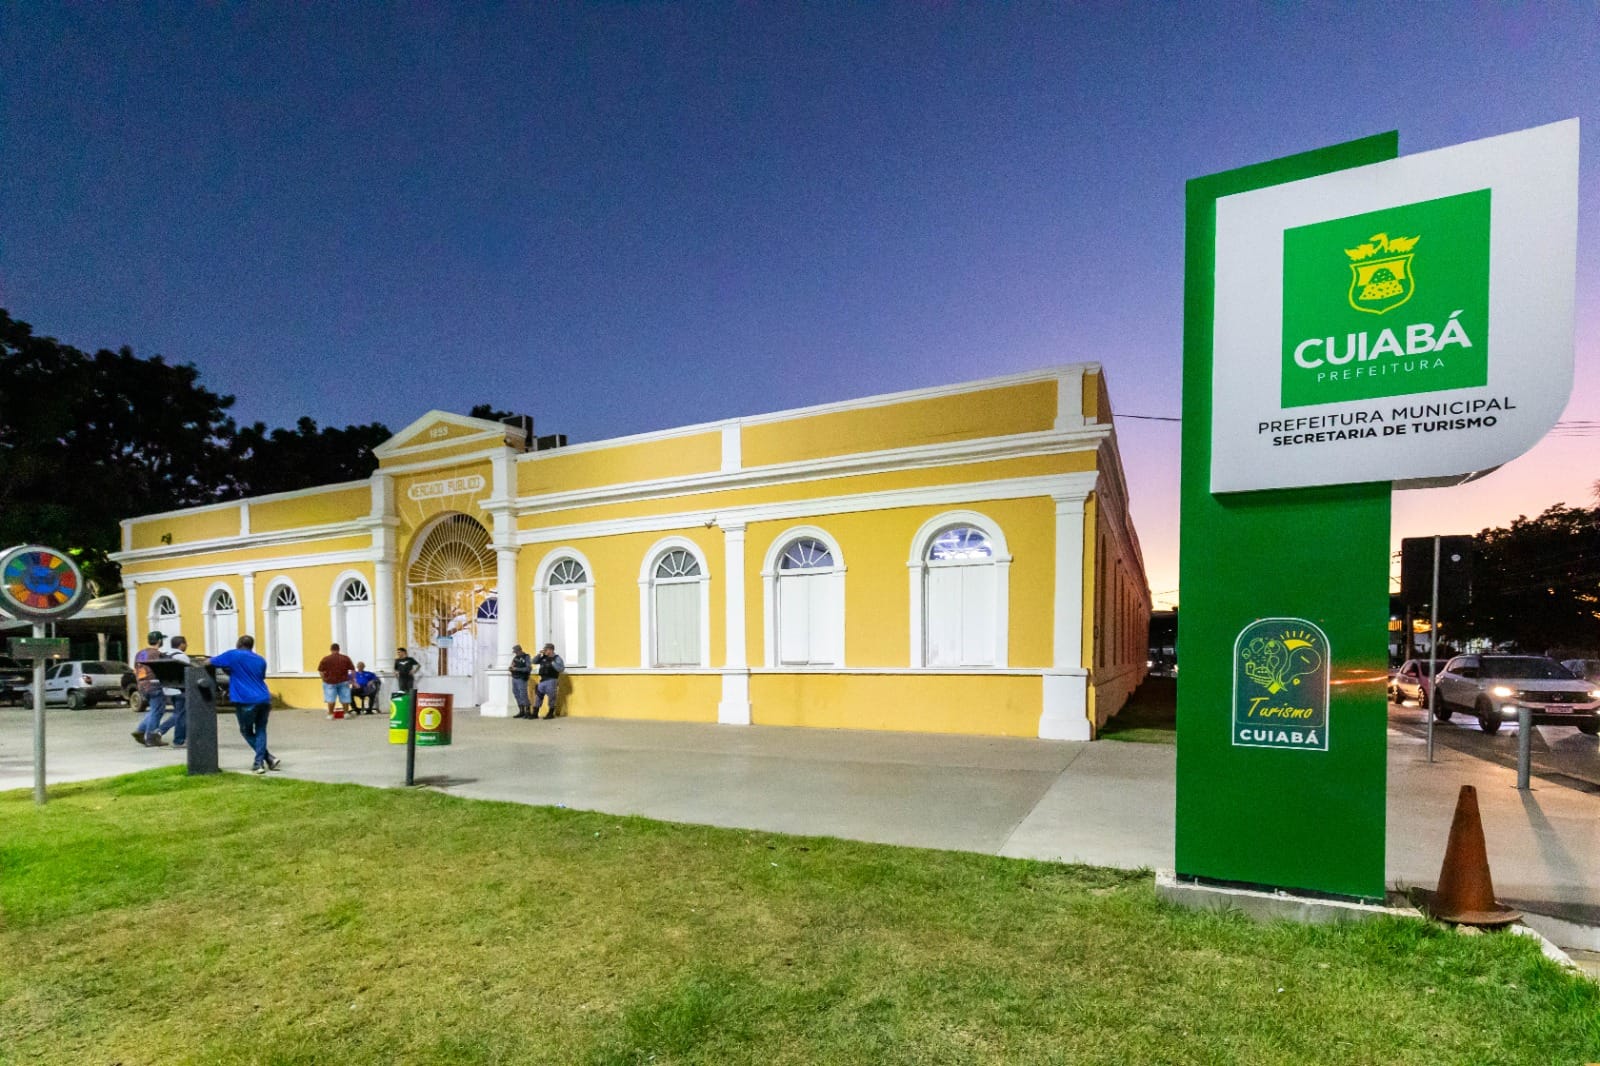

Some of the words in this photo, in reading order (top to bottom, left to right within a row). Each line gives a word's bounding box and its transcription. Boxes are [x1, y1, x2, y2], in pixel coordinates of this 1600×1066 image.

[1293, 309, 1473, 369] CUIABÁ
[1317, 357, 1445, 383] PREFEITURA
[1258, 410, 1383, 434] PREFEITURA
[1392, 396, 1517, 419] MUNICIPAL
[1272, 428, 1377, 446] SECRETARIA
[1383, 424, 1407, 436] DE
[1412, 415, 1498, 434] TURISMO
[1247, 697, 1313, 719] Turismo
[1239, 729, 1319, 745] CUIABÁ
